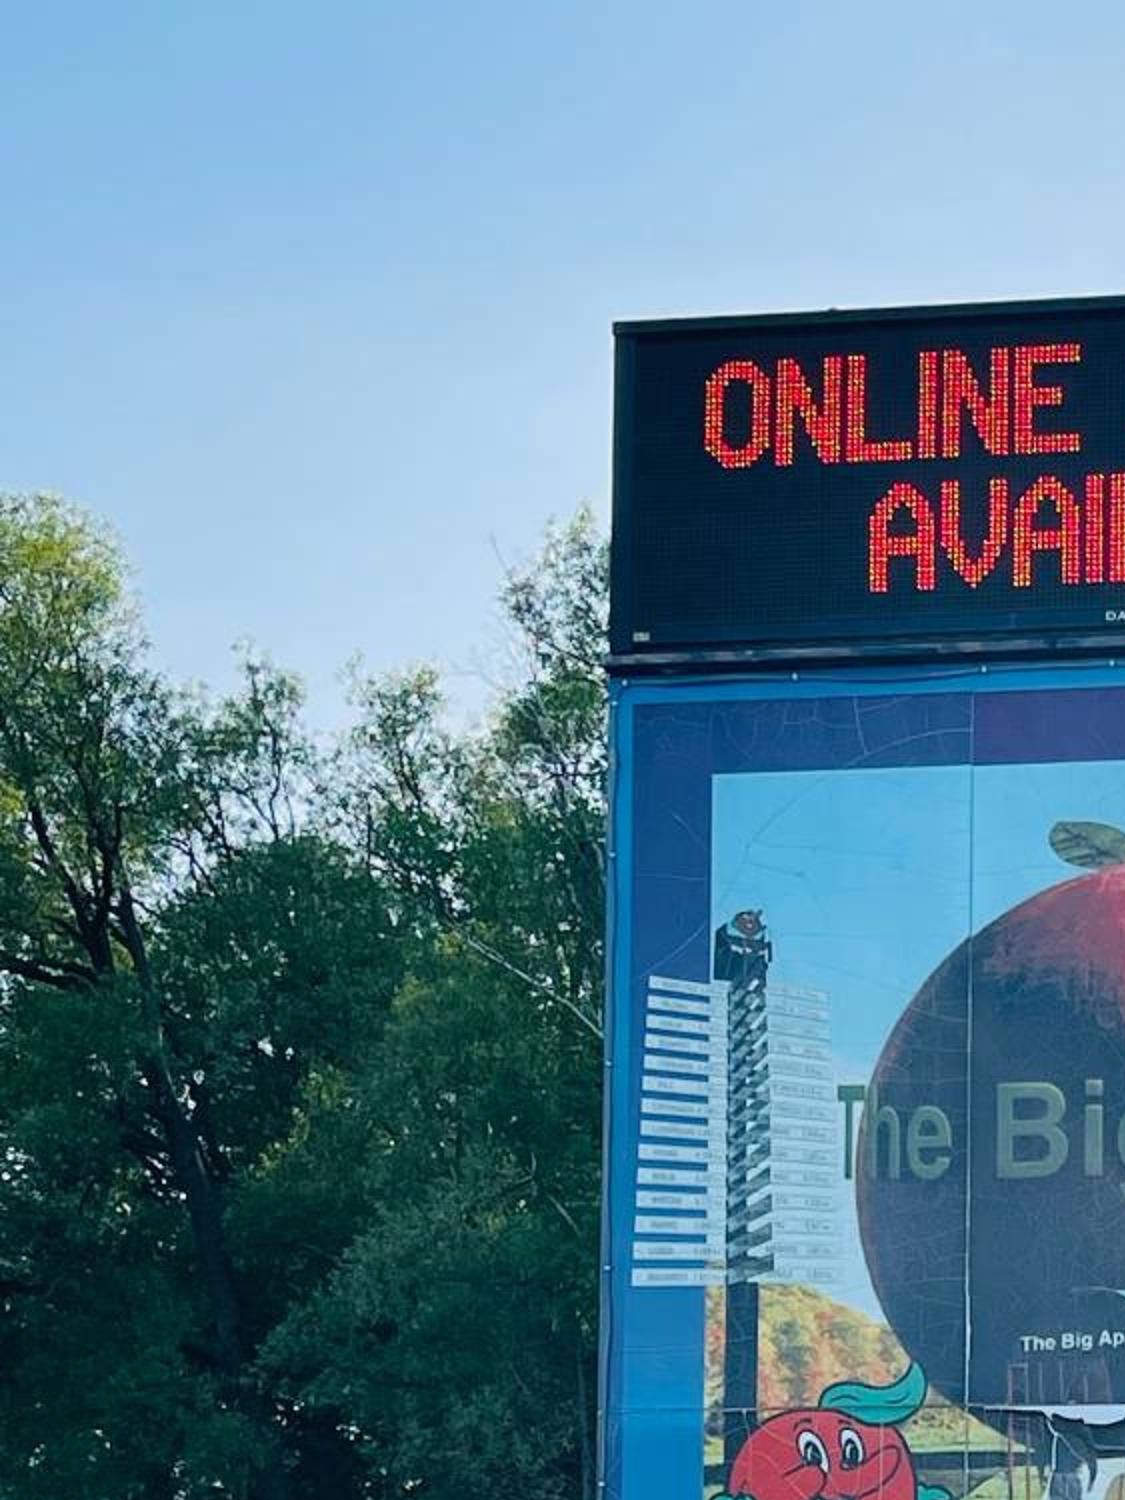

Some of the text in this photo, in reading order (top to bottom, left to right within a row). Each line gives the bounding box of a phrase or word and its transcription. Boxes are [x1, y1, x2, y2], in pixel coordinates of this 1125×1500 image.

[703, 342, 1082, 470] ONLINE
[837, 1082, 953, 1180] The
[1020, 1335, 1057, 1352] The
[1061, 1332, 1093, 1351] Big
